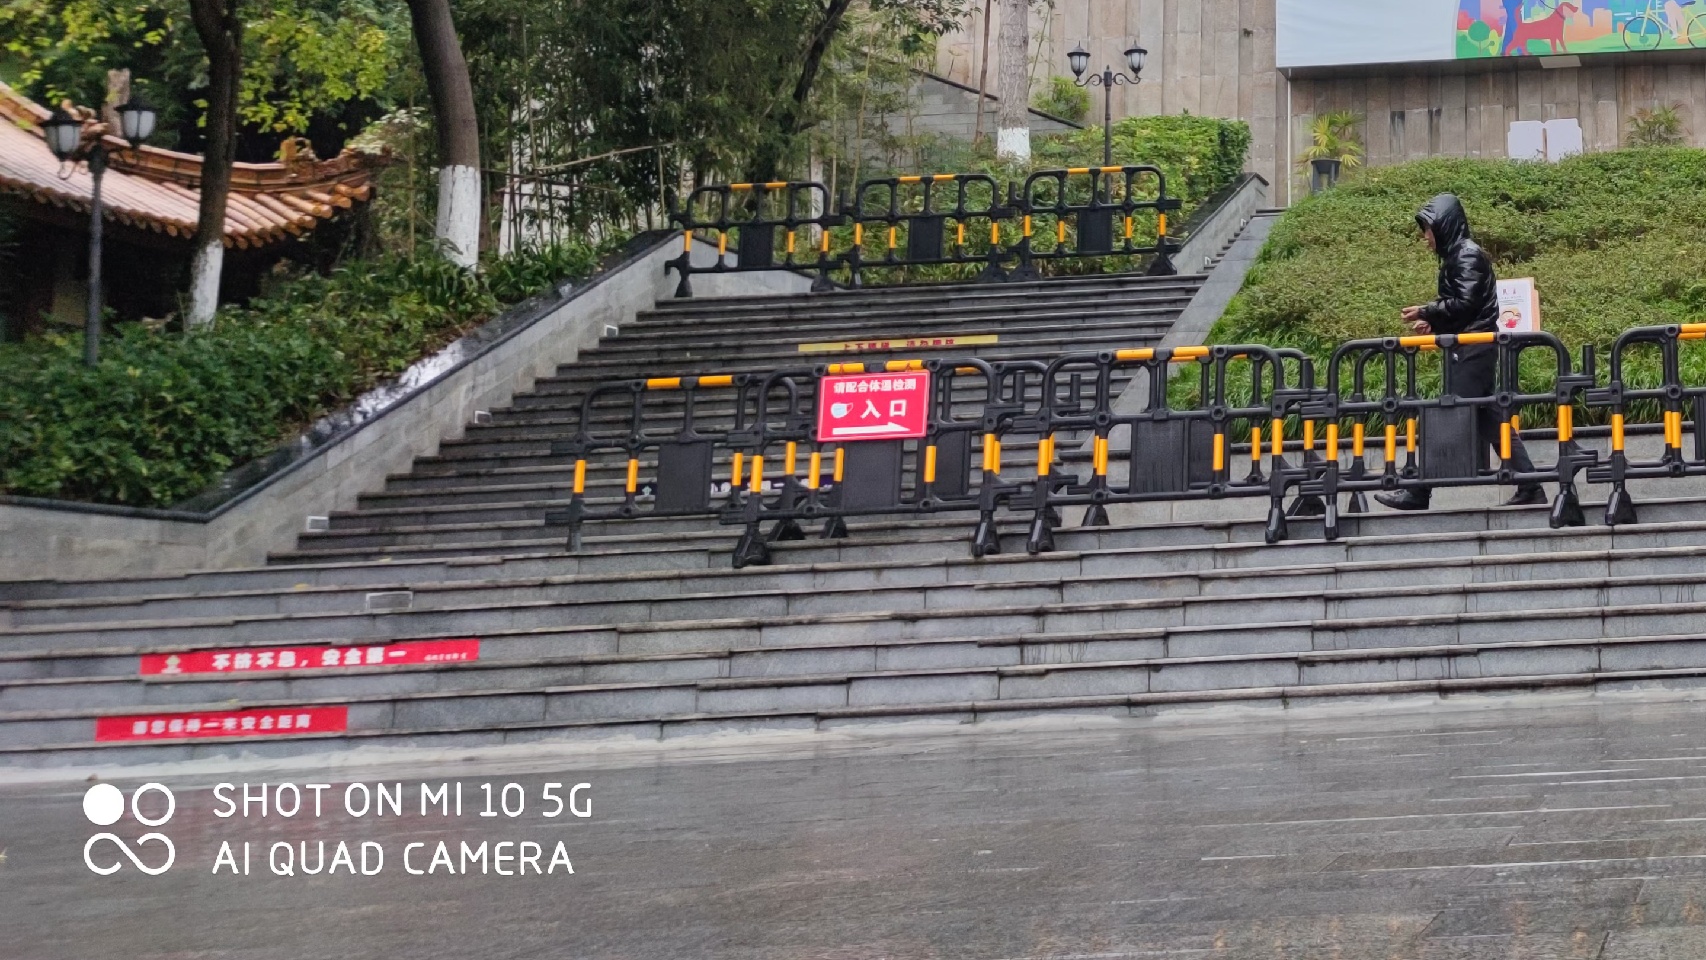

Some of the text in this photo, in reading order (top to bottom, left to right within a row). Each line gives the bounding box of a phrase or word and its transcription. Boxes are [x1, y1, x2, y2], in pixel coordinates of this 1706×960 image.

[833, 378, 917, 394] 请配合体温检测
[860, 399, 907, 419] 入口
